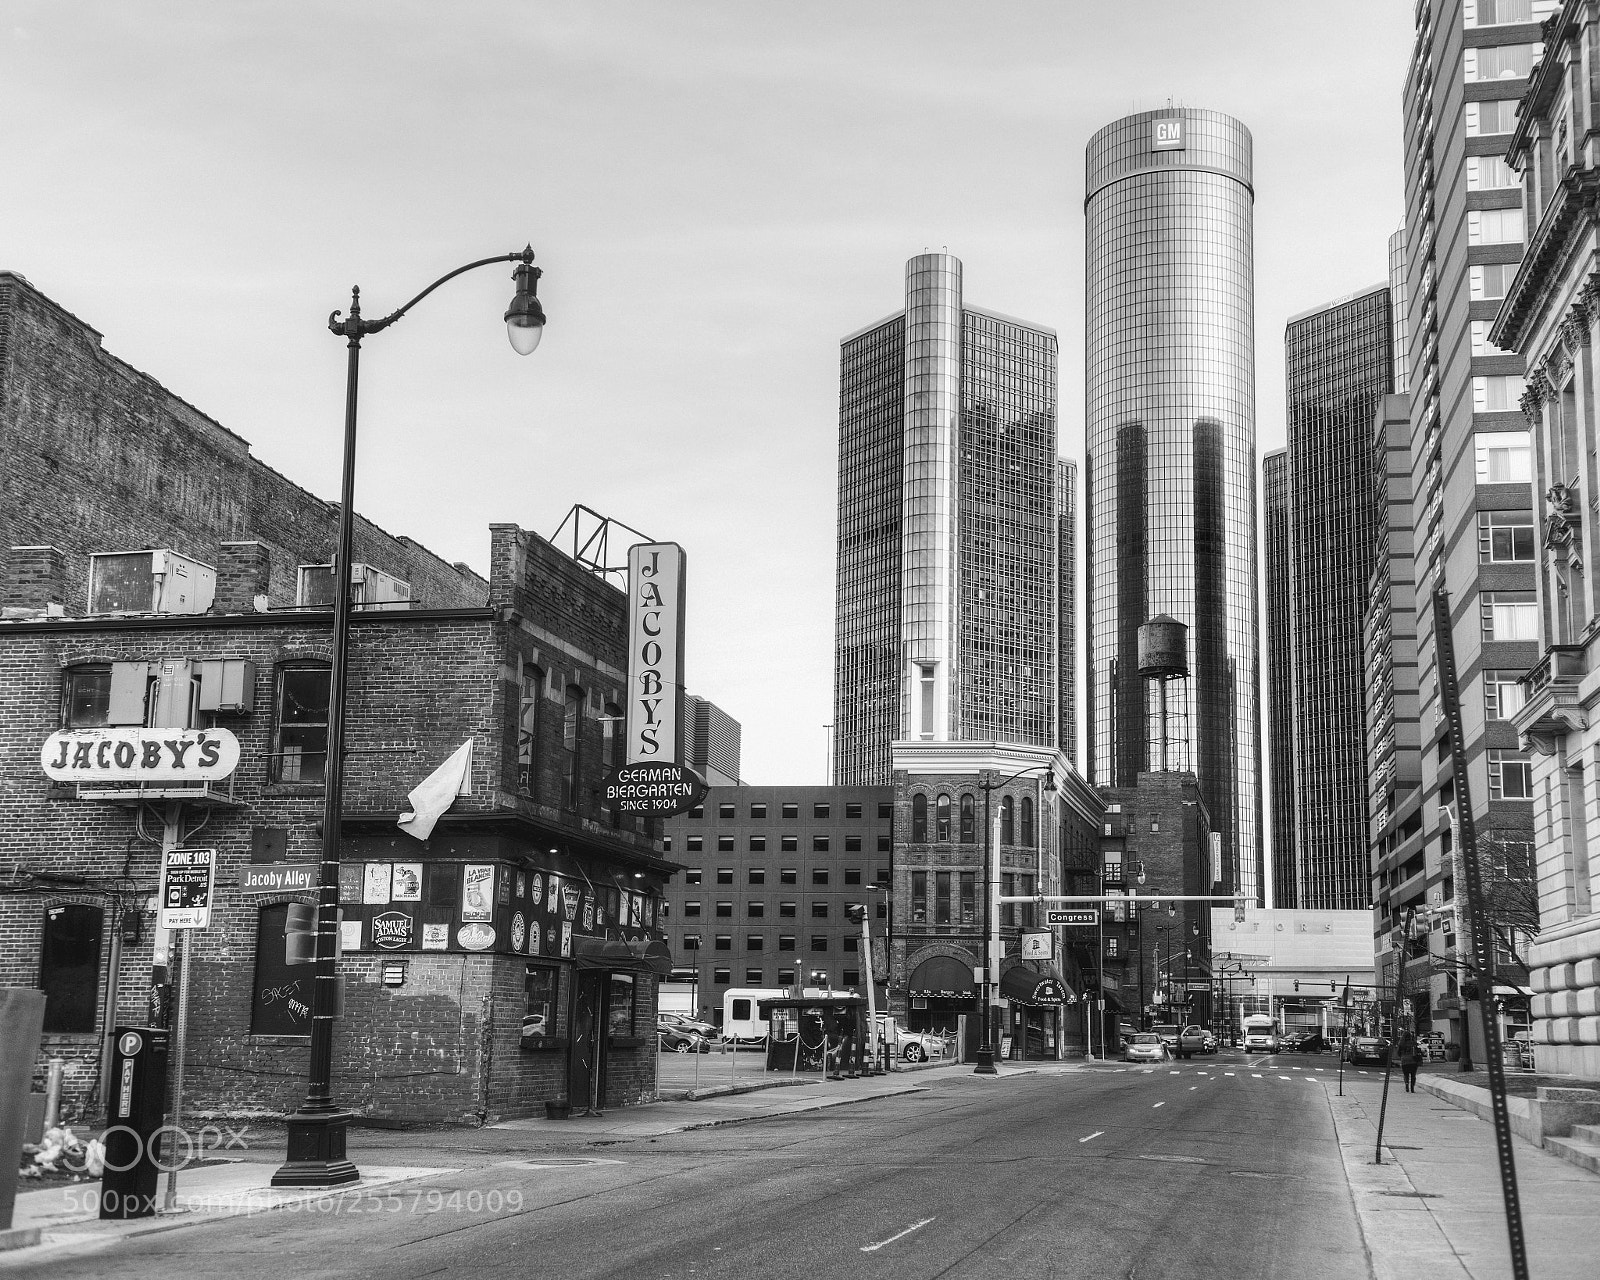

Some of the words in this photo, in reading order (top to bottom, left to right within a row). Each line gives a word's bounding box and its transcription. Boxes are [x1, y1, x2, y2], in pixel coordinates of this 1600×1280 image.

[1157, 123, 1180, 139] GM
[639, 551, 666, 755] JACOBY'S
[51, 733, 220, 769] JACOBY'S
[619, 767, 681, 782] GERMAN
[607, 782, 692, 798] BIERGARTEN
[620, 800, 650, 811] SINCE
[652, 799, 678, 810] 1904
[168, 852, 192, 865] ZONE
[193, 852, 210, 865] 103
[244, 872, 282, 888] Jacoby
[284, 870, 311, 887] Alley
[374, 919, 410, 930] SAMUEL
[1050, 913, 1093, 922] Congress
[377, 927, 407, 938] ADAMS
[125, 1036, 137, 1052] P
[121, 1086, 130, 1115] HERE
